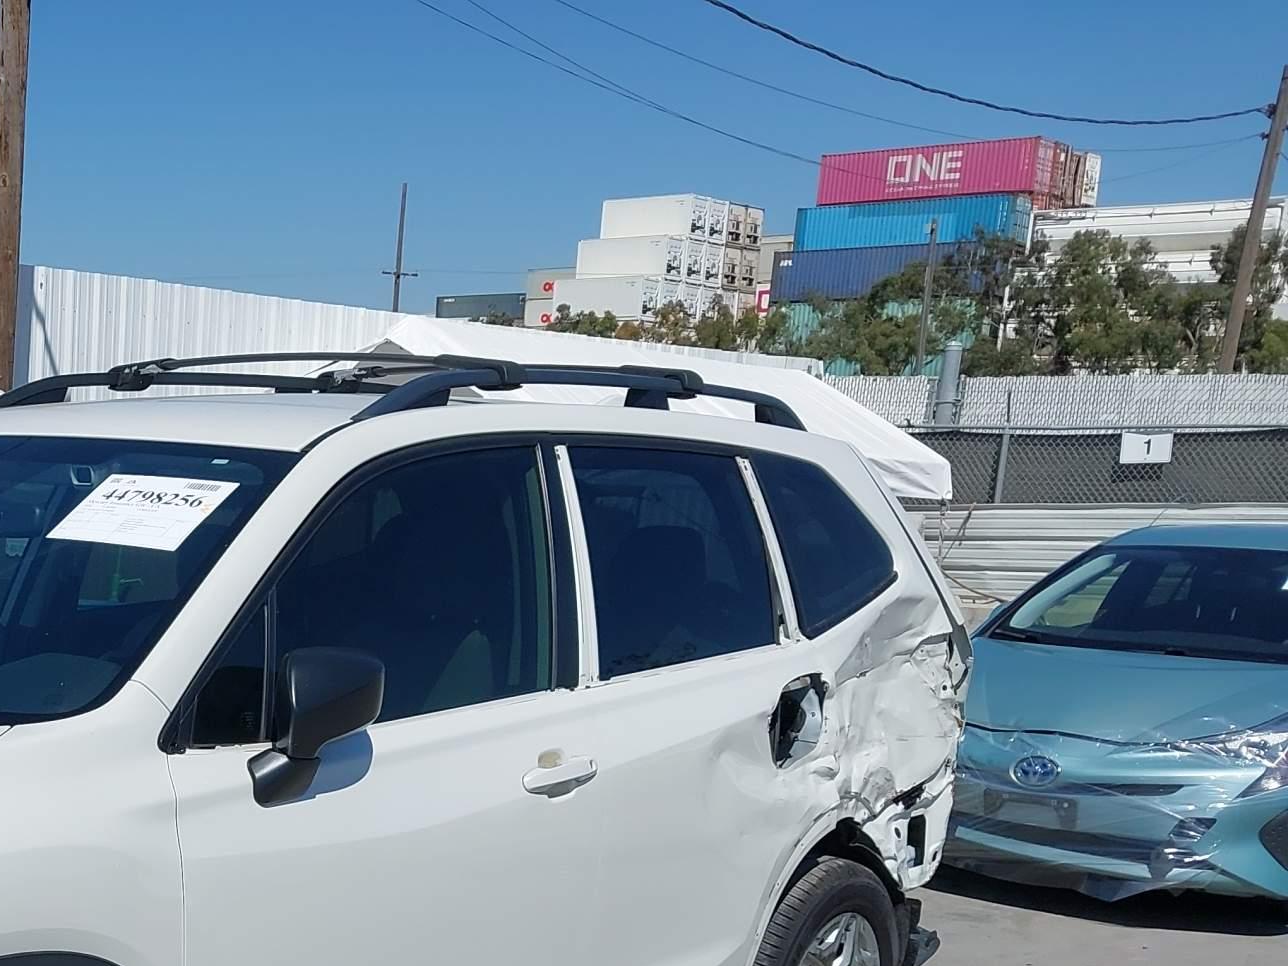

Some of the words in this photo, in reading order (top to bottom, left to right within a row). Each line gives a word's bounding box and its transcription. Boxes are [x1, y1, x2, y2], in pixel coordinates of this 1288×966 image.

[886, 150, 963, 184] ONE
[1143, 438, 1152, 455] 1
[102, 488, 208, 508] 44798256
